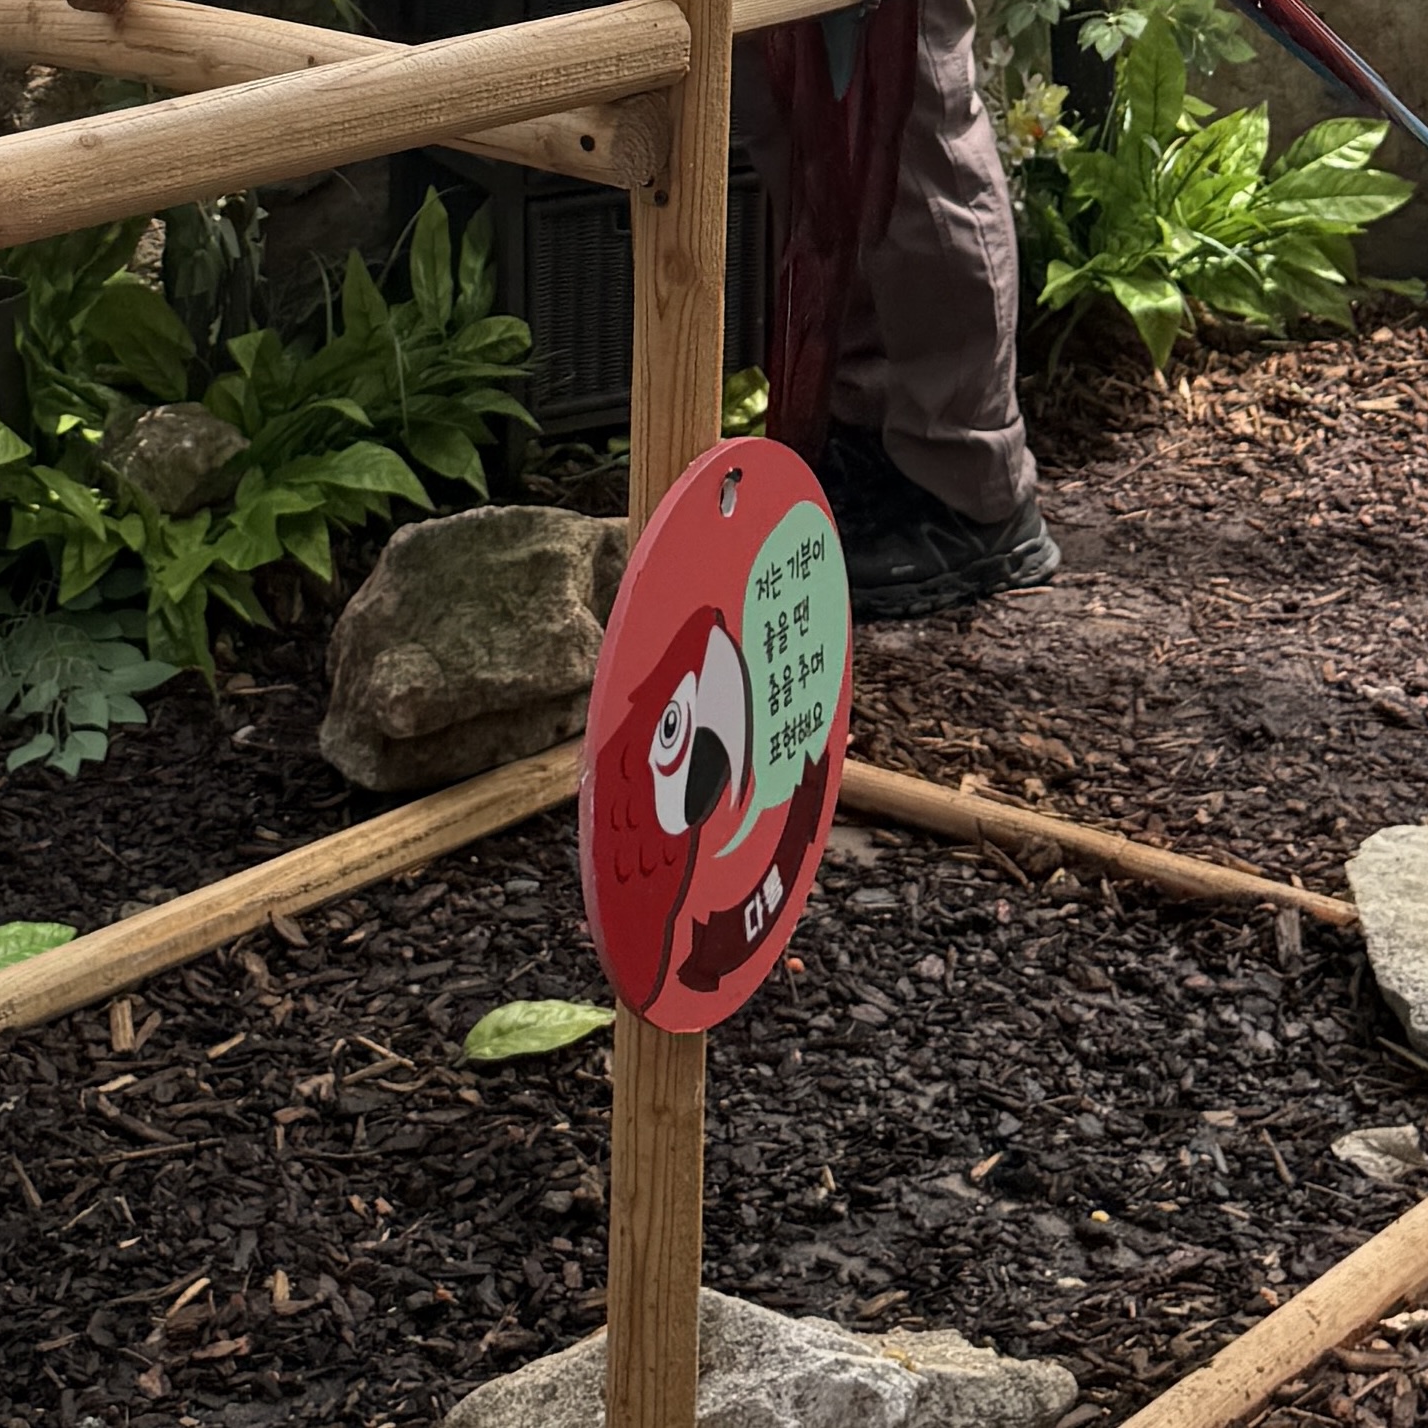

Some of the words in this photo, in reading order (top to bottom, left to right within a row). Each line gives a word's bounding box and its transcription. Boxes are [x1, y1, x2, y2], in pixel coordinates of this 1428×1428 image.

[755, 561, 784, 602] 저는
[786, 533, 825, 580] 기분이
[768, 664, 794, 717] 춤을
[798, 643, 825, 690] 추며
[769, 701, 825, 766] 표현해요
